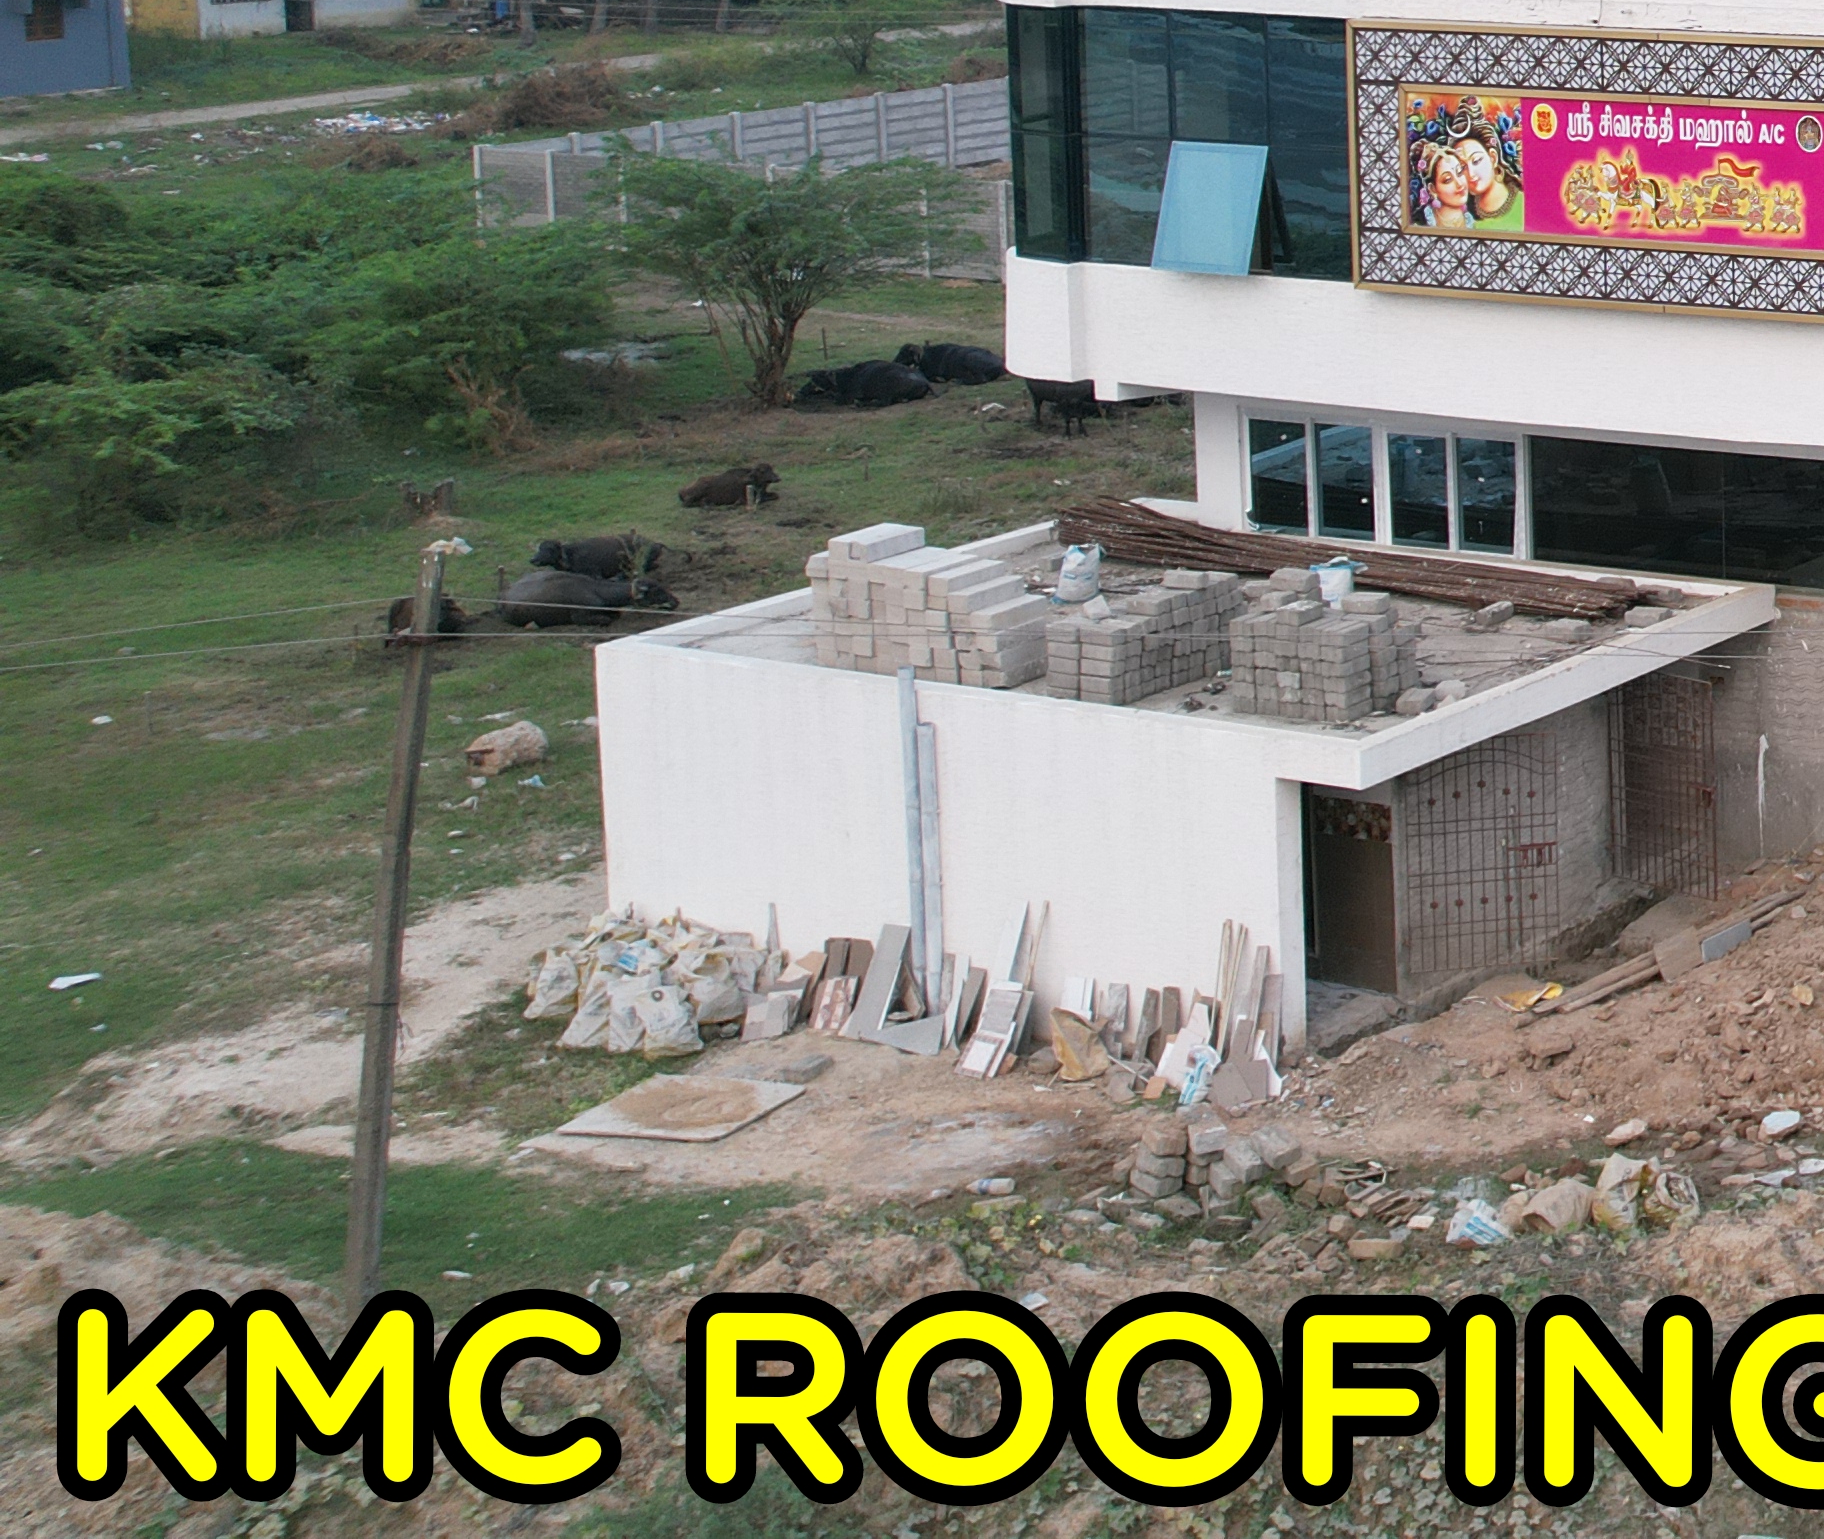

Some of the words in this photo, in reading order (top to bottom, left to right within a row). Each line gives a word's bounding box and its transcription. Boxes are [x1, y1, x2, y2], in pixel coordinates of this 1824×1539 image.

[1599, 104, 1673, 147] சிவசக்தி
[1679, 109, 1753, 150] மஹால்
[1758, 123, 1785, 144] A/C
